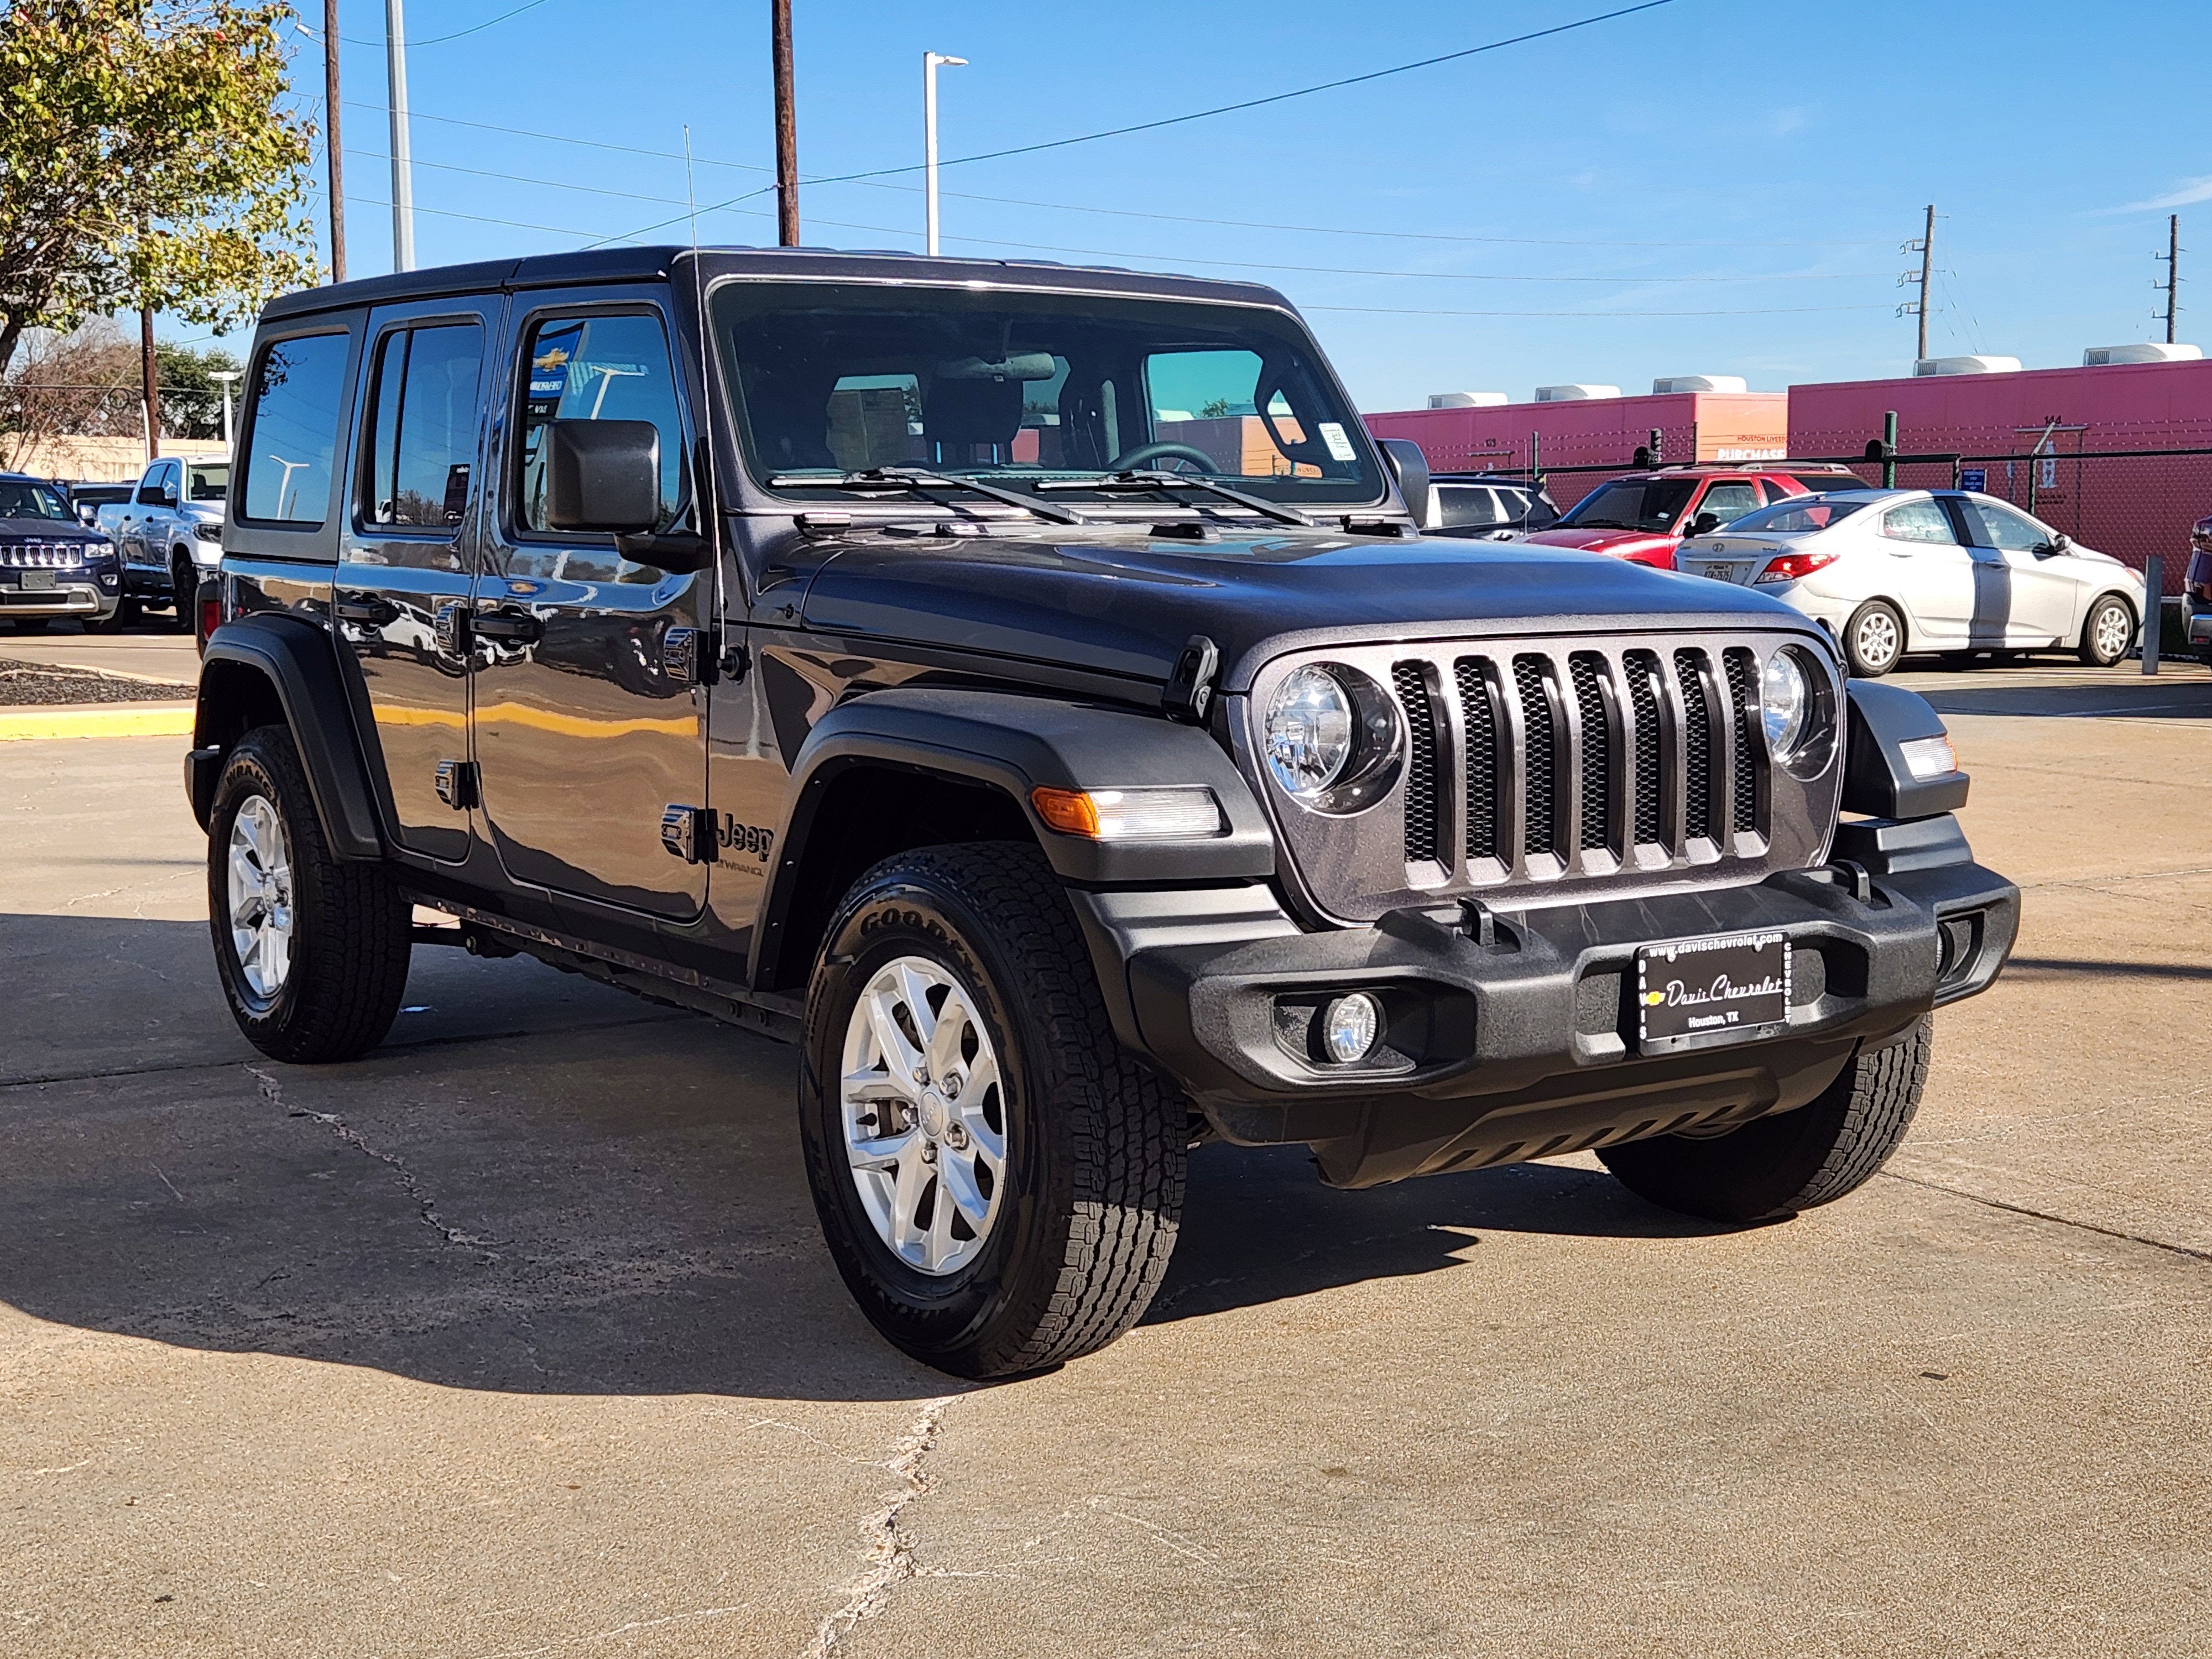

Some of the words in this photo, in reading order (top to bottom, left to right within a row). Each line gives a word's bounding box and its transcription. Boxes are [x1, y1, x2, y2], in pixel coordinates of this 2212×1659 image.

[2044, 415, 2062, 424] 144
[716, 813, 774, 862] Jeep
[1649, 933, 1783, 957] www.davischevrolet.com
[1639, 959, 1647, 1040] DAVIS
[1666, 980, 1710, 1007] Davis
[1710, 974, 1783, 1001] Chevrolet
[1688, 1015, 1726, 1029] Houston,
[1726, 1011, 1739, 1023] TX
